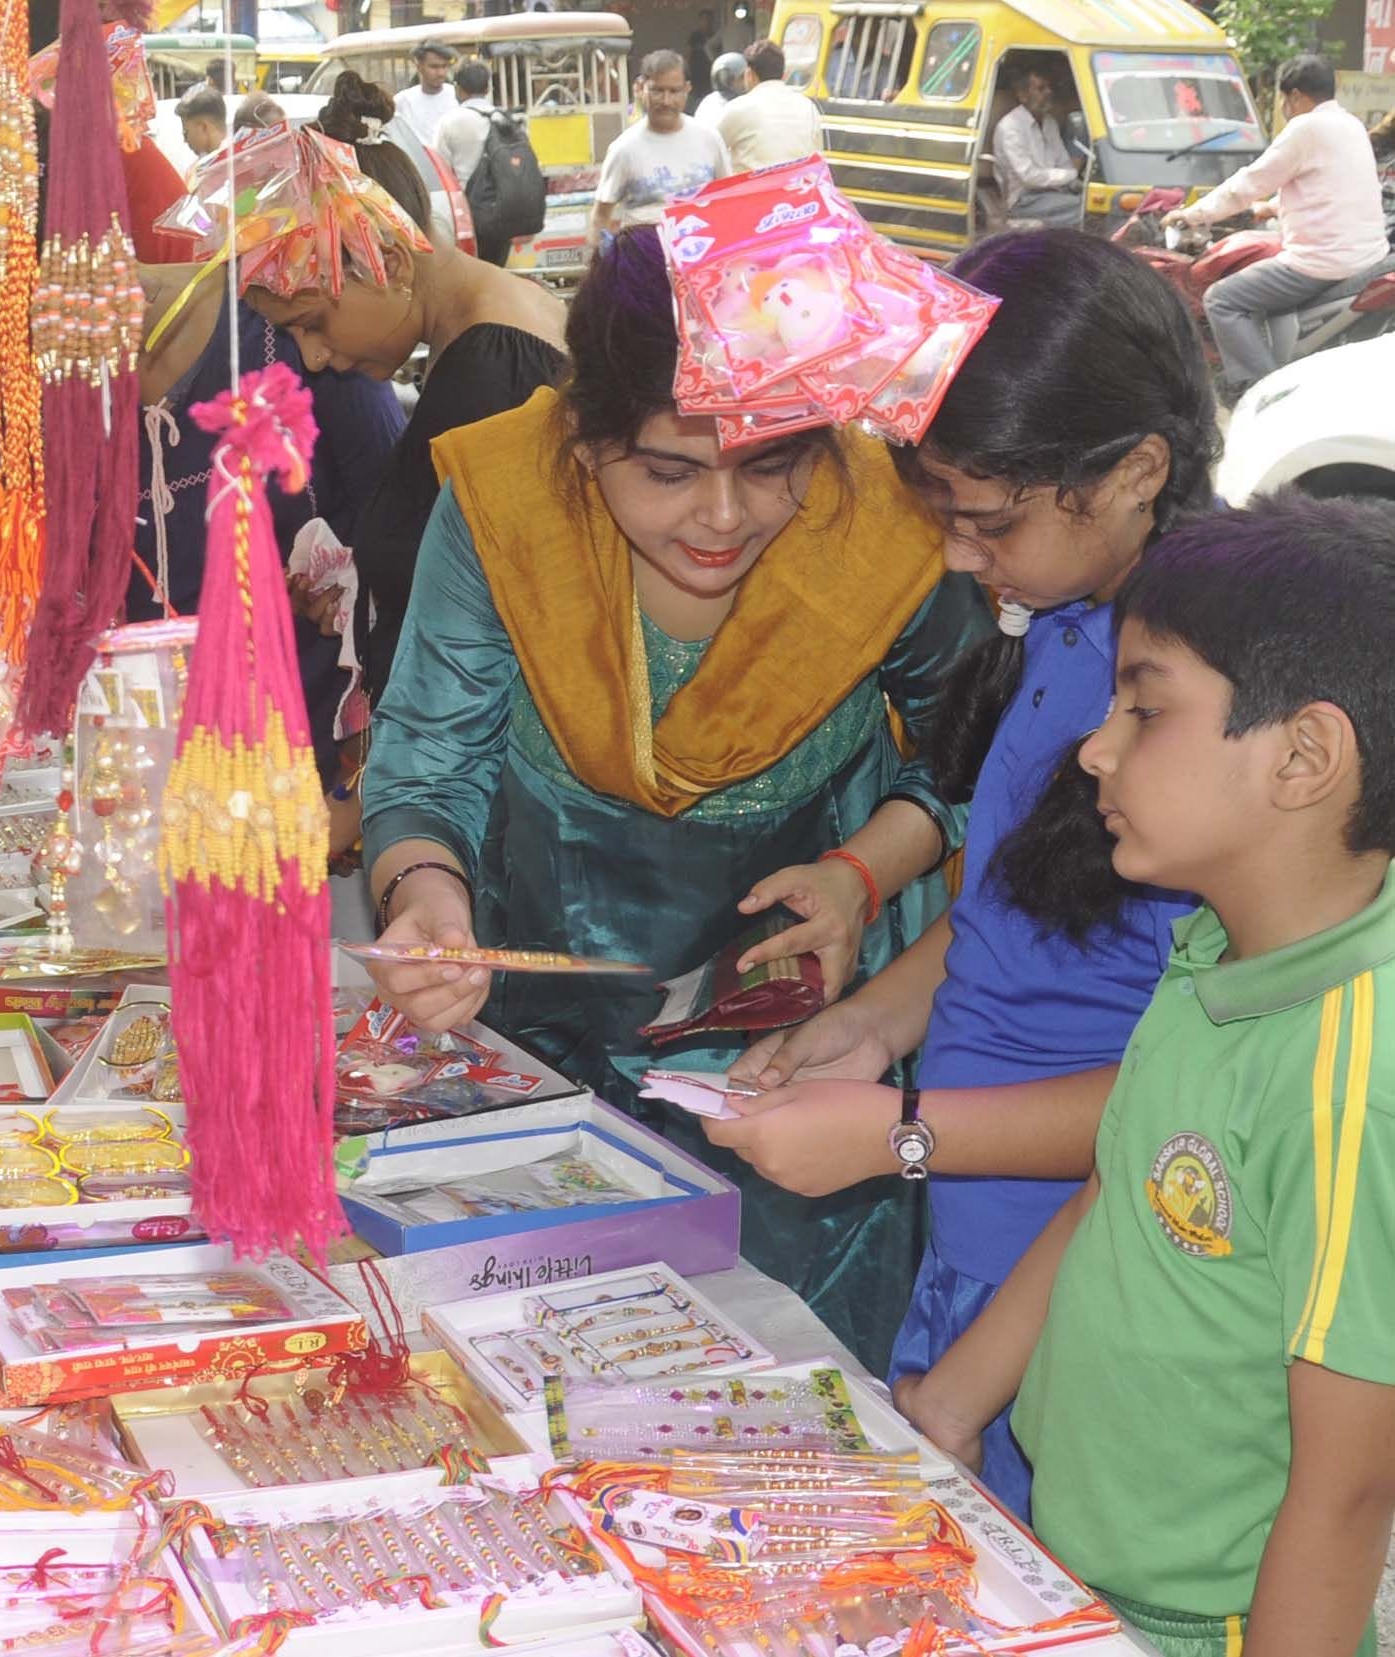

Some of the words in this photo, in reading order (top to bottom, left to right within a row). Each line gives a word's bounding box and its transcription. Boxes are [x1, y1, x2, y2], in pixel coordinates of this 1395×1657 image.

[1187, 1139, 1219, 1179] GLOBAL
[469, 1255, 531, 1292] Things
[537, 1255, 592, 1283] Little
